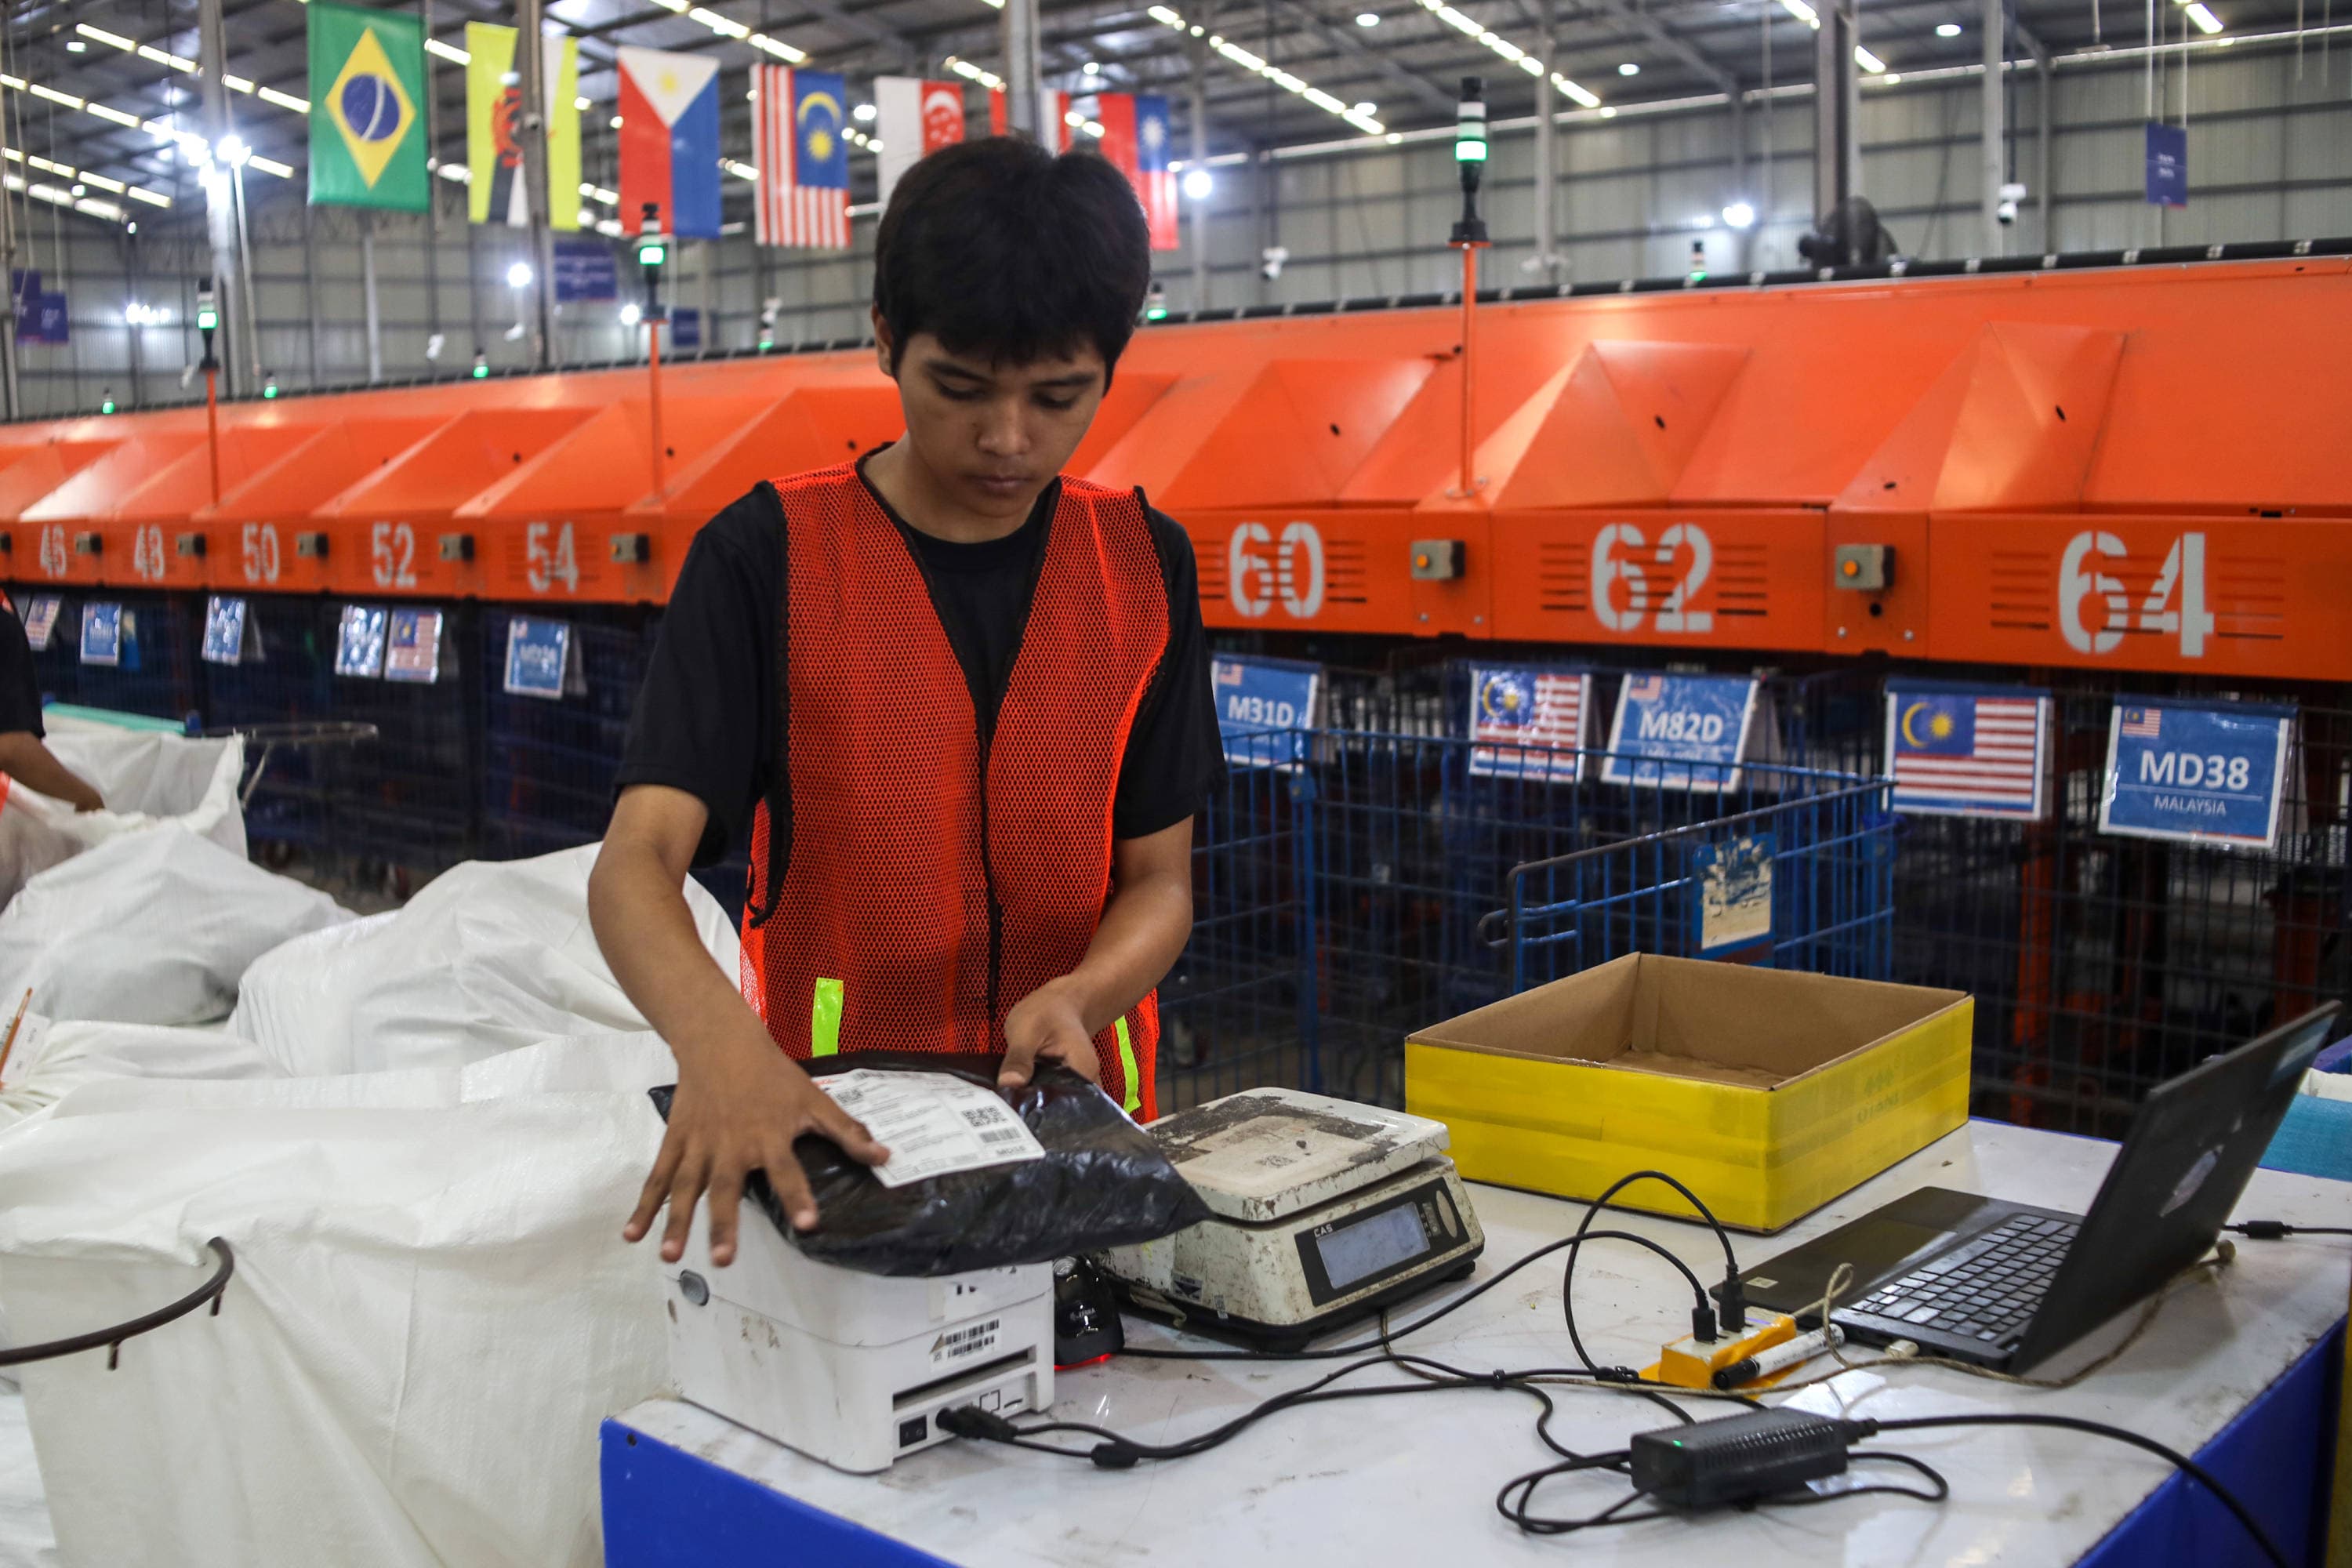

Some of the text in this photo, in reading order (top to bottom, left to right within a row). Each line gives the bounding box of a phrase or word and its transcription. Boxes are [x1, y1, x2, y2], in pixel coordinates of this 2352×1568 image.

[242, 522, 280, 584] 50
[372, 522, 416, 588] 52
[527, 521, 579, 593] 54
[1229, 521, 1324, 618] 60
[1592, 523, 1714, 631] 62
[2059, 530, 2214, 658] 64
[1228, 695, 1294, 728] M31D
[1639, 710, 1723, 742] M82D
[2140, 750, 2250, 790] MD38
[2154, 795, 2227, 816] MALAYSIA
[1313, 1224, 1334, 1237] CAS
